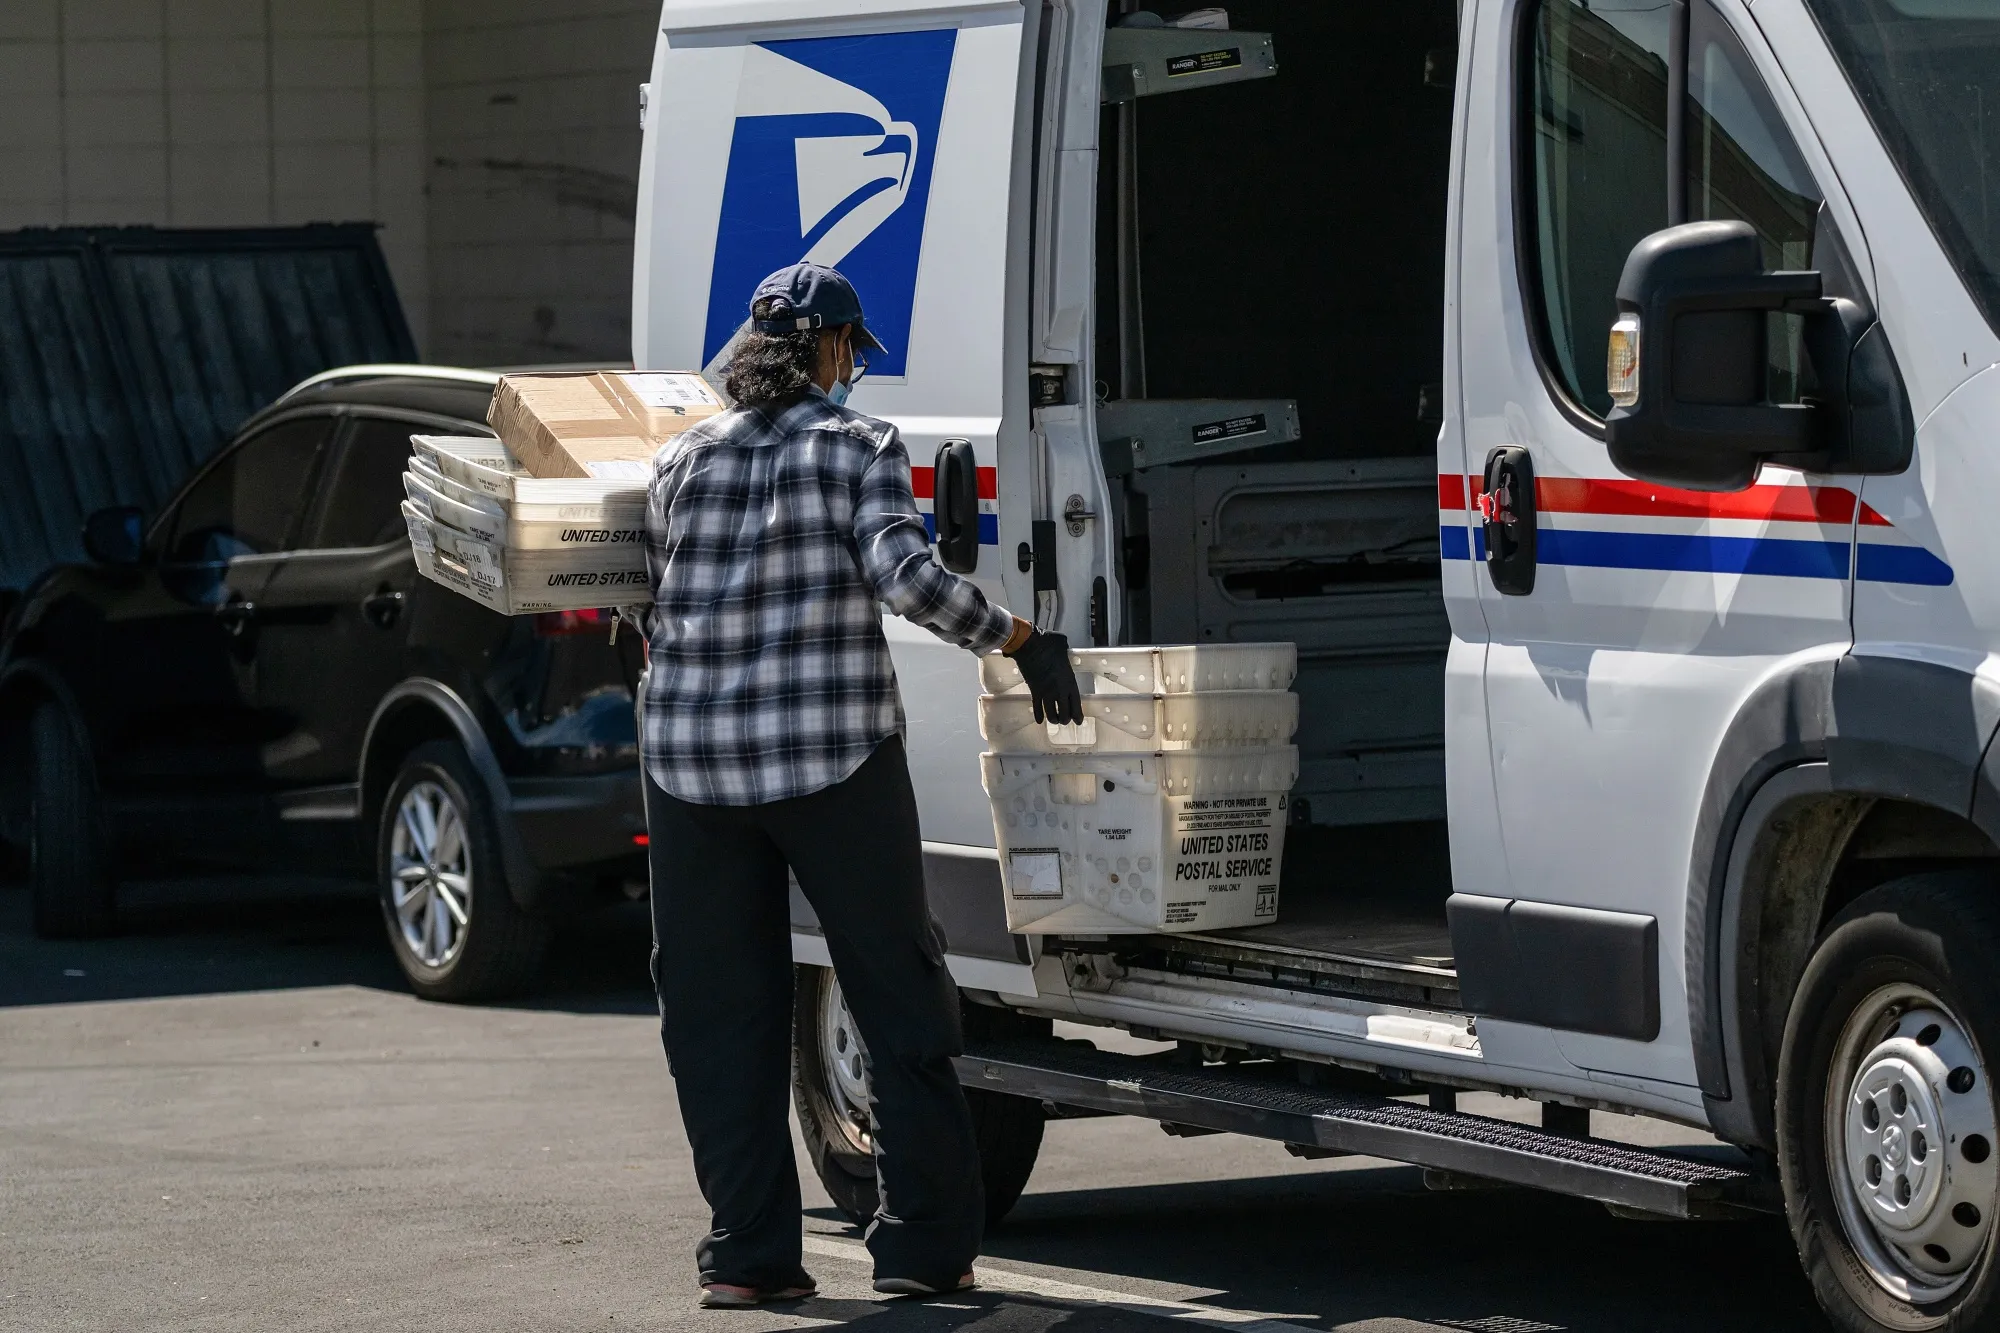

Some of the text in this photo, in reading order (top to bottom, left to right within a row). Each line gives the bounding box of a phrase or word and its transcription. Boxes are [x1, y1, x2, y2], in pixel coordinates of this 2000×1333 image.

[561, 529, 646, 542] UNITED STAT
[547, 571, 649, 586] UNITED STATES
[1184, 801, 1209, 810] WARNING
[1213, 800, 1224, 808] NOT
[1225, 800, 1235, 808] FOR
[1236, 798, 1256, 807] PRIVATE
[1256, 798, 1267, 807] USE
[1181, 833, 1269, 855] UNITED STATES
[1176, 857, 1272, 881] POSTAL SERVICE
[1219, 884, 1228, 892] MAIL
[1229, 883, 1241, 892] ONLY
